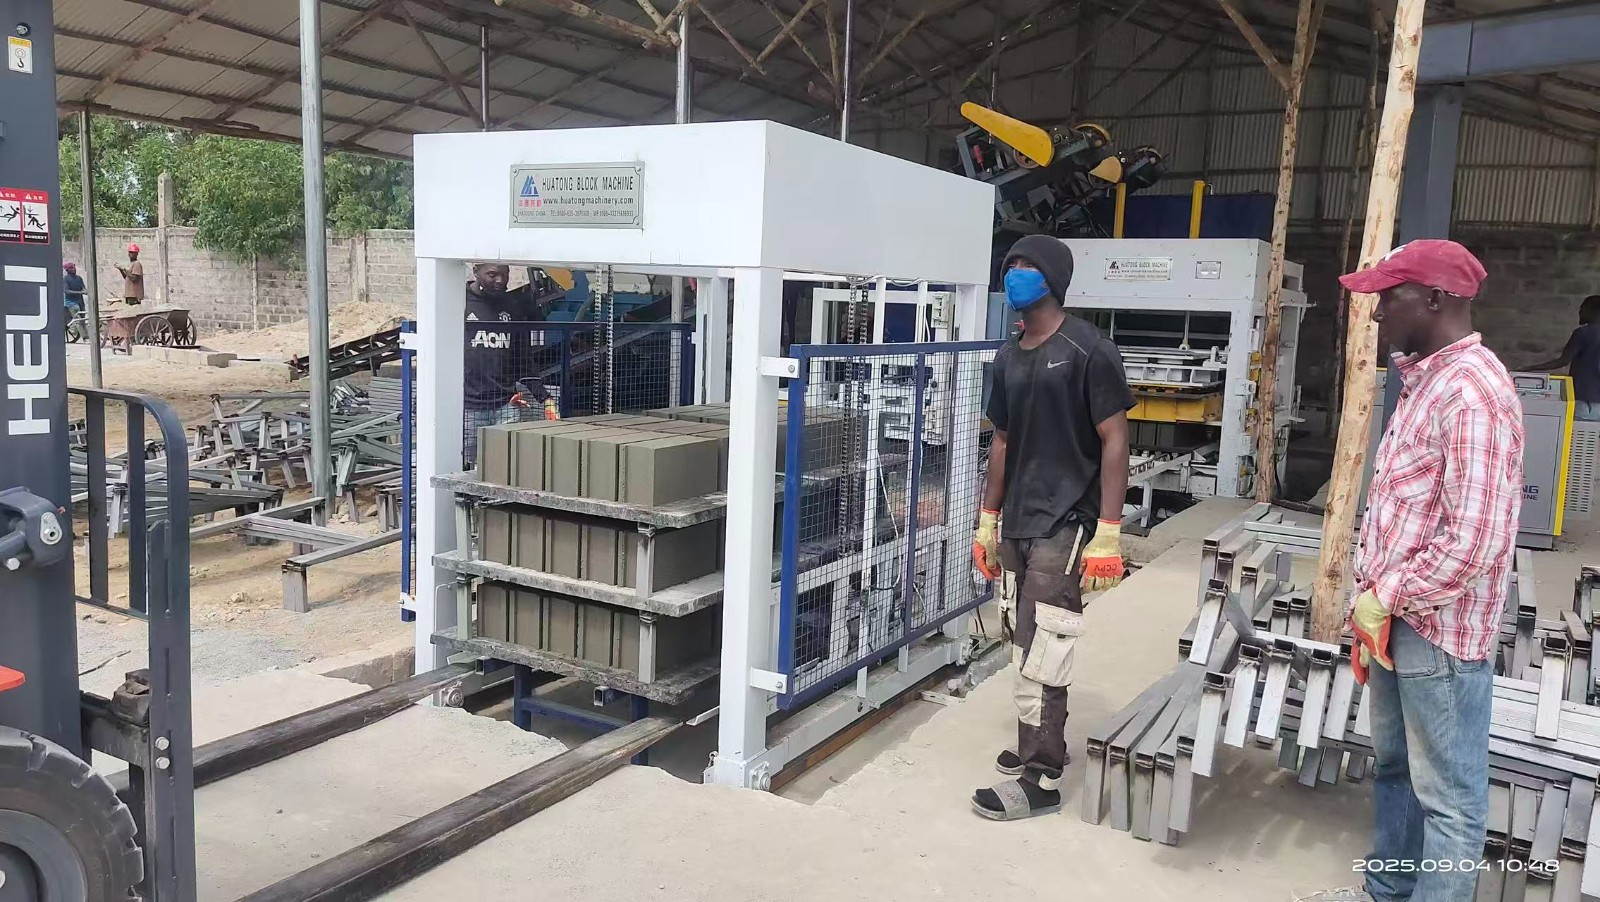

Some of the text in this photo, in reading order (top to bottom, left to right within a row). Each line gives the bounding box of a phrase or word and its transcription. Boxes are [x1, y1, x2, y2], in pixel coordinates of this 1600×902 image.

[542, 176, 634, 191] HUATONG BLOCK MACHINE
[543, 196, 634, 206] www.huatongmachinery.com
[470, 330, 511, 349] AON
[4, 265, 51, 436] HELI
